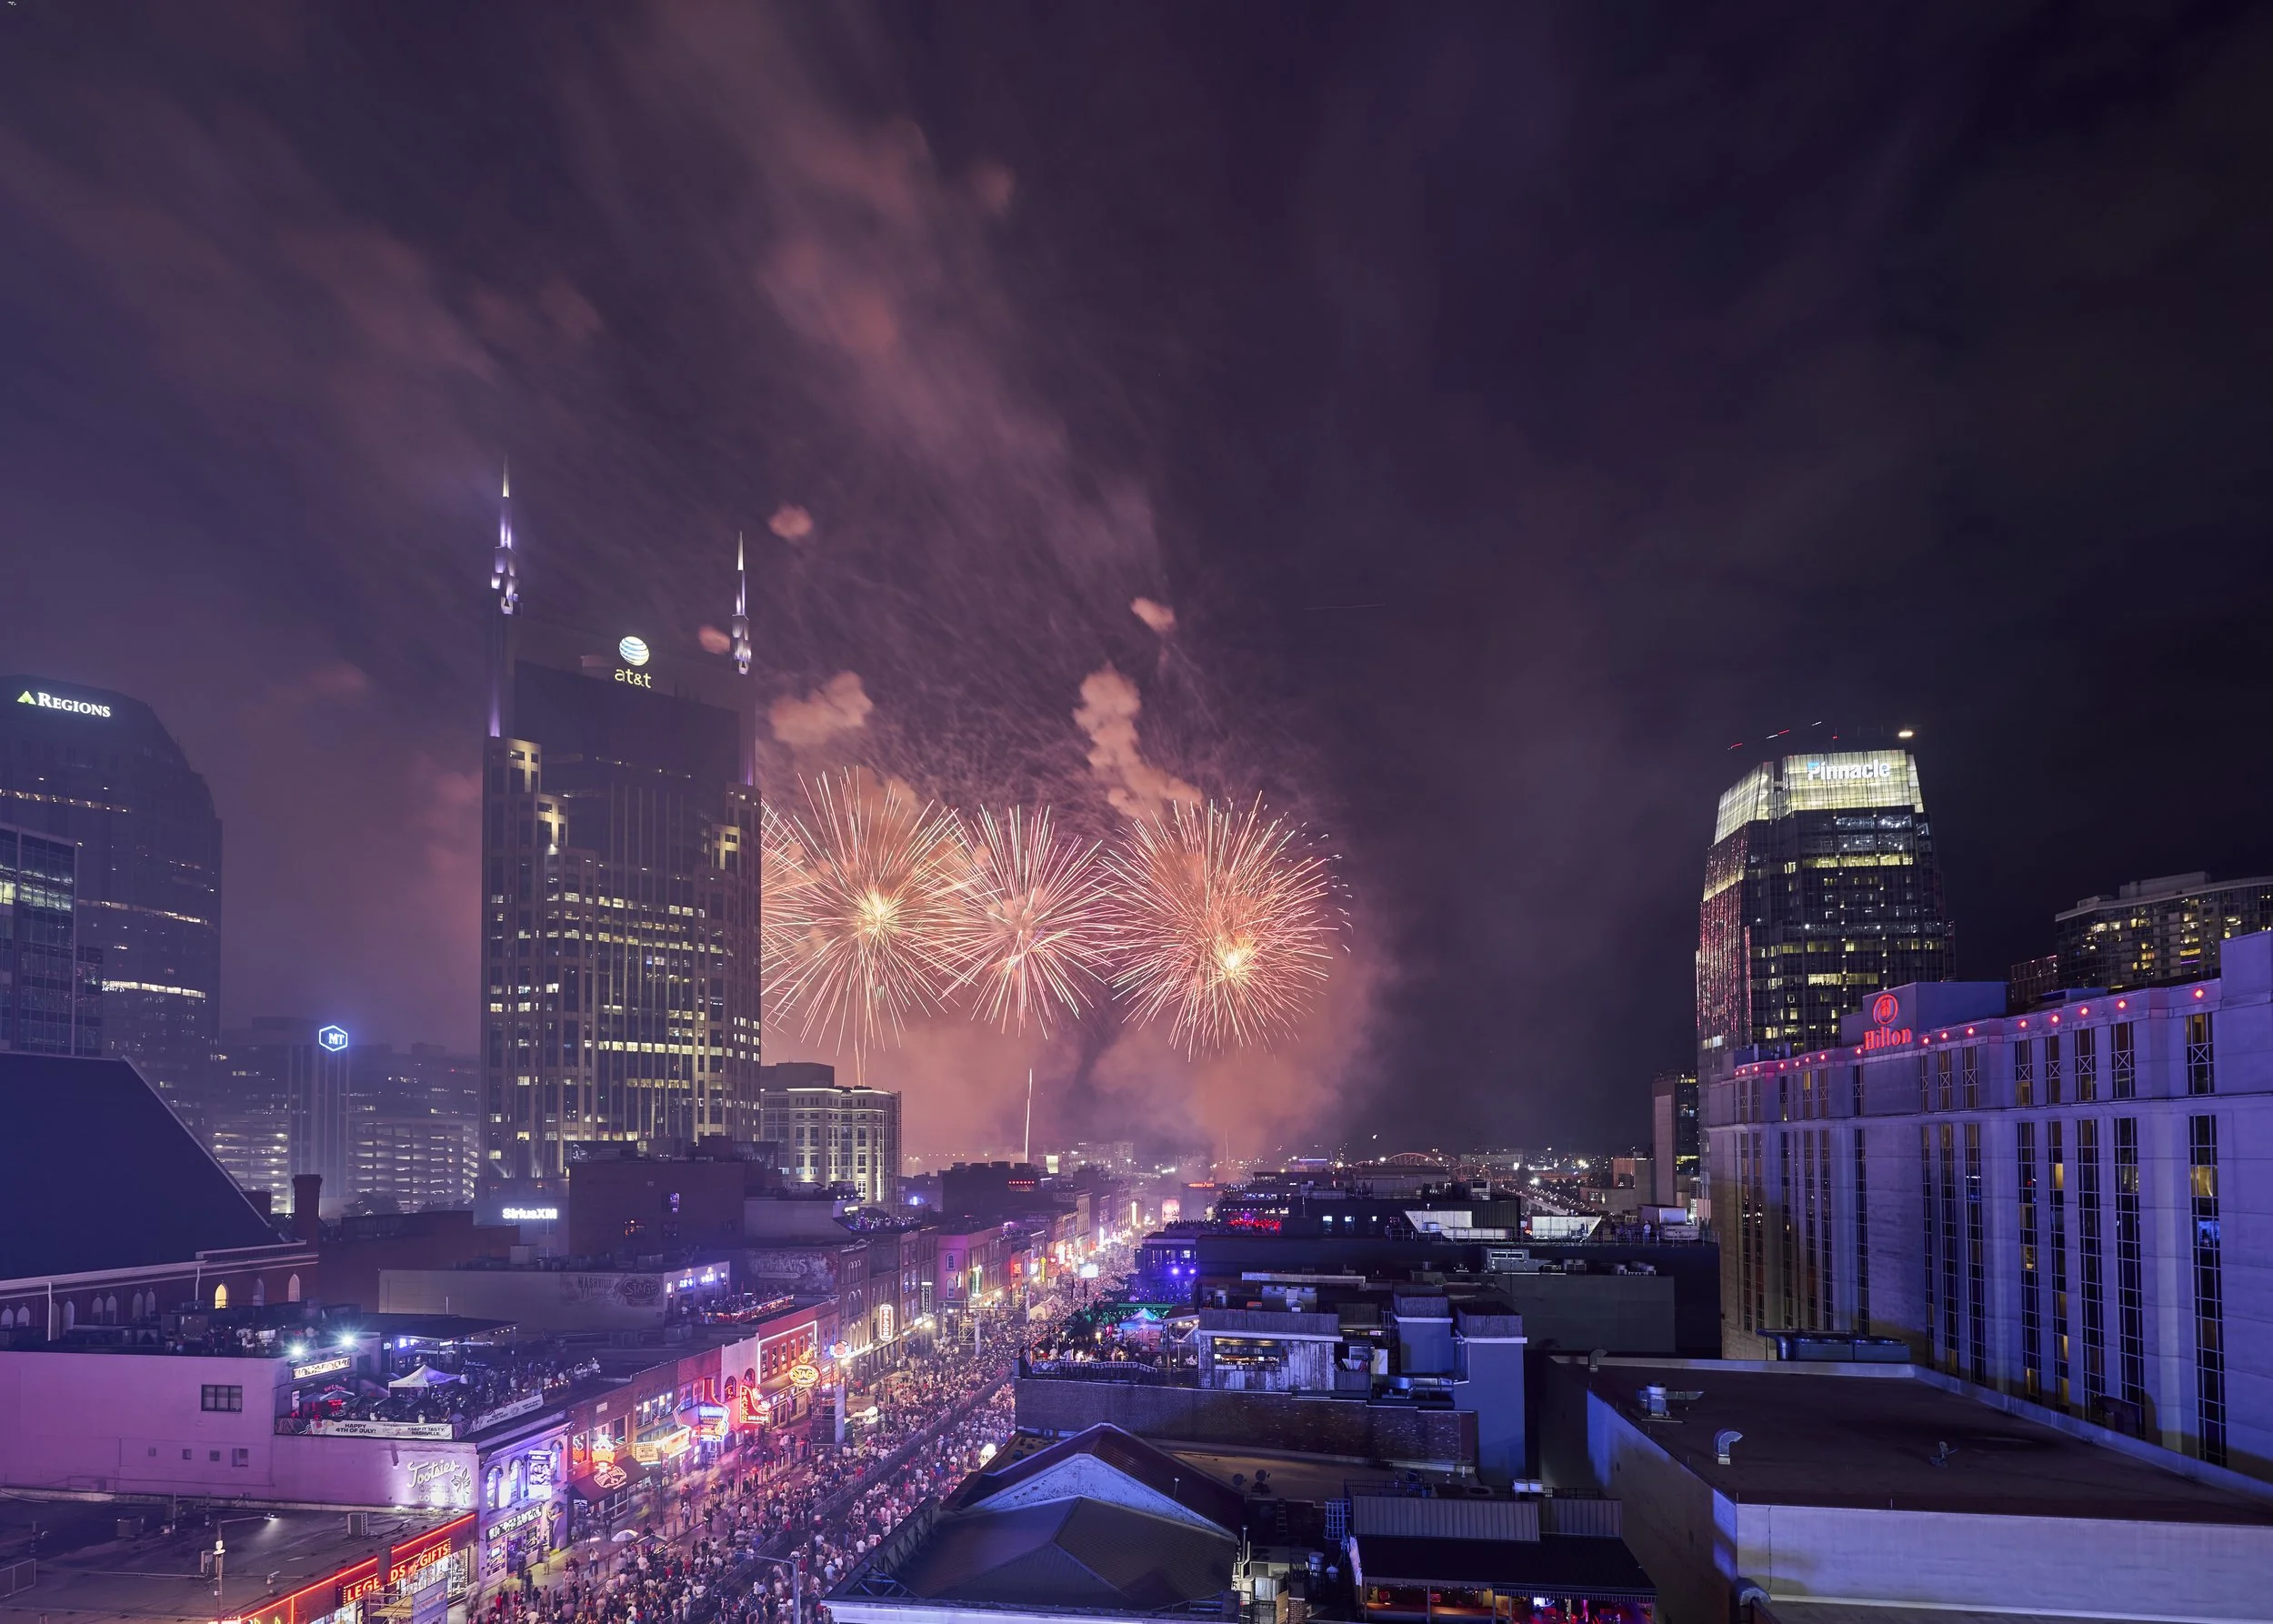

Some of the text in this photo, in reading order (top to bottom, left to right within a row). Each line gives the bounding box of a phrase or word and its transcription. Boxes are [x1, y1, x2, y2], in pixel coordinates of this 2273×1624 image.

[37, 692, 111, 717] REGIONS
[1807, 759, 1891, 780] Pinnacle
[1864, 1026, 1912, 1050] Hilton
[502, 1208, 557, 1219] SiriusXM
[346, 1565, 406, 1601] LEGEDS
[419, 1544, 448, 1567] GIFTS
